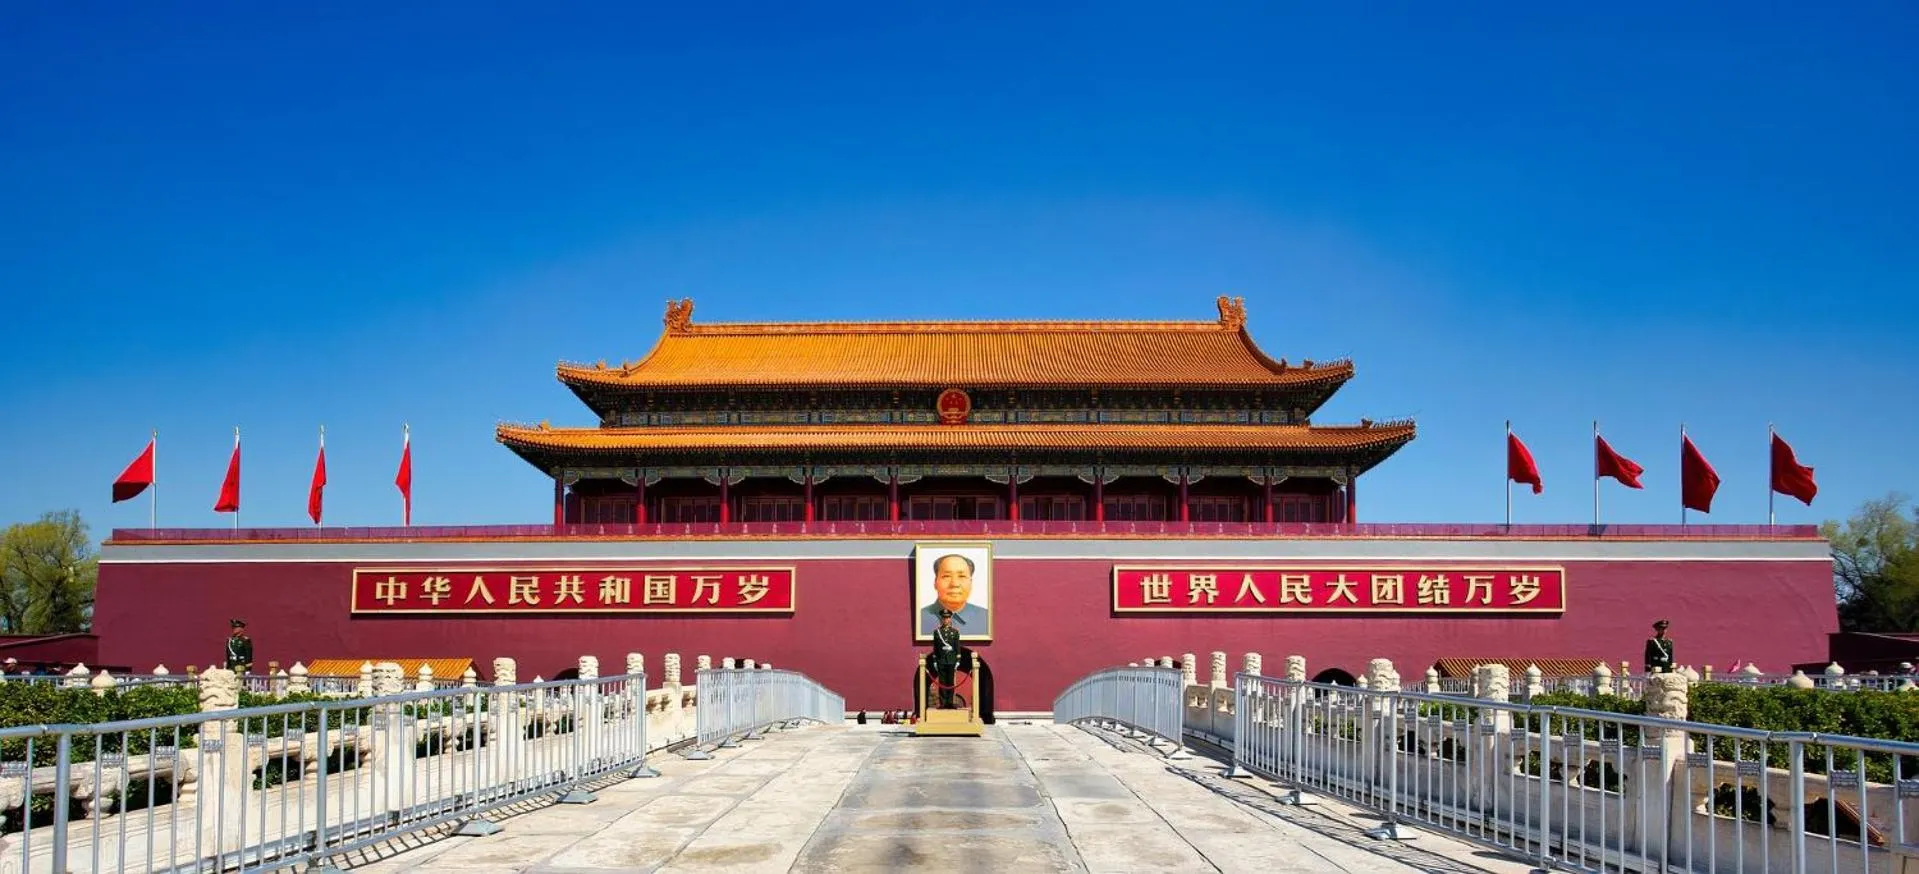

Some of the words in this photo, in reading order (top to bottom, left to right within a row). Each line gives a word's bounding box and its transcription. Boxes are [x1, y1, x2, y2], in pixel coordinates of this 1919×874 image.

[375, 574, 770, 605] 中华人民共和国万岁
[1140, 573, 1542, 604] 世界人民大团结万岁
